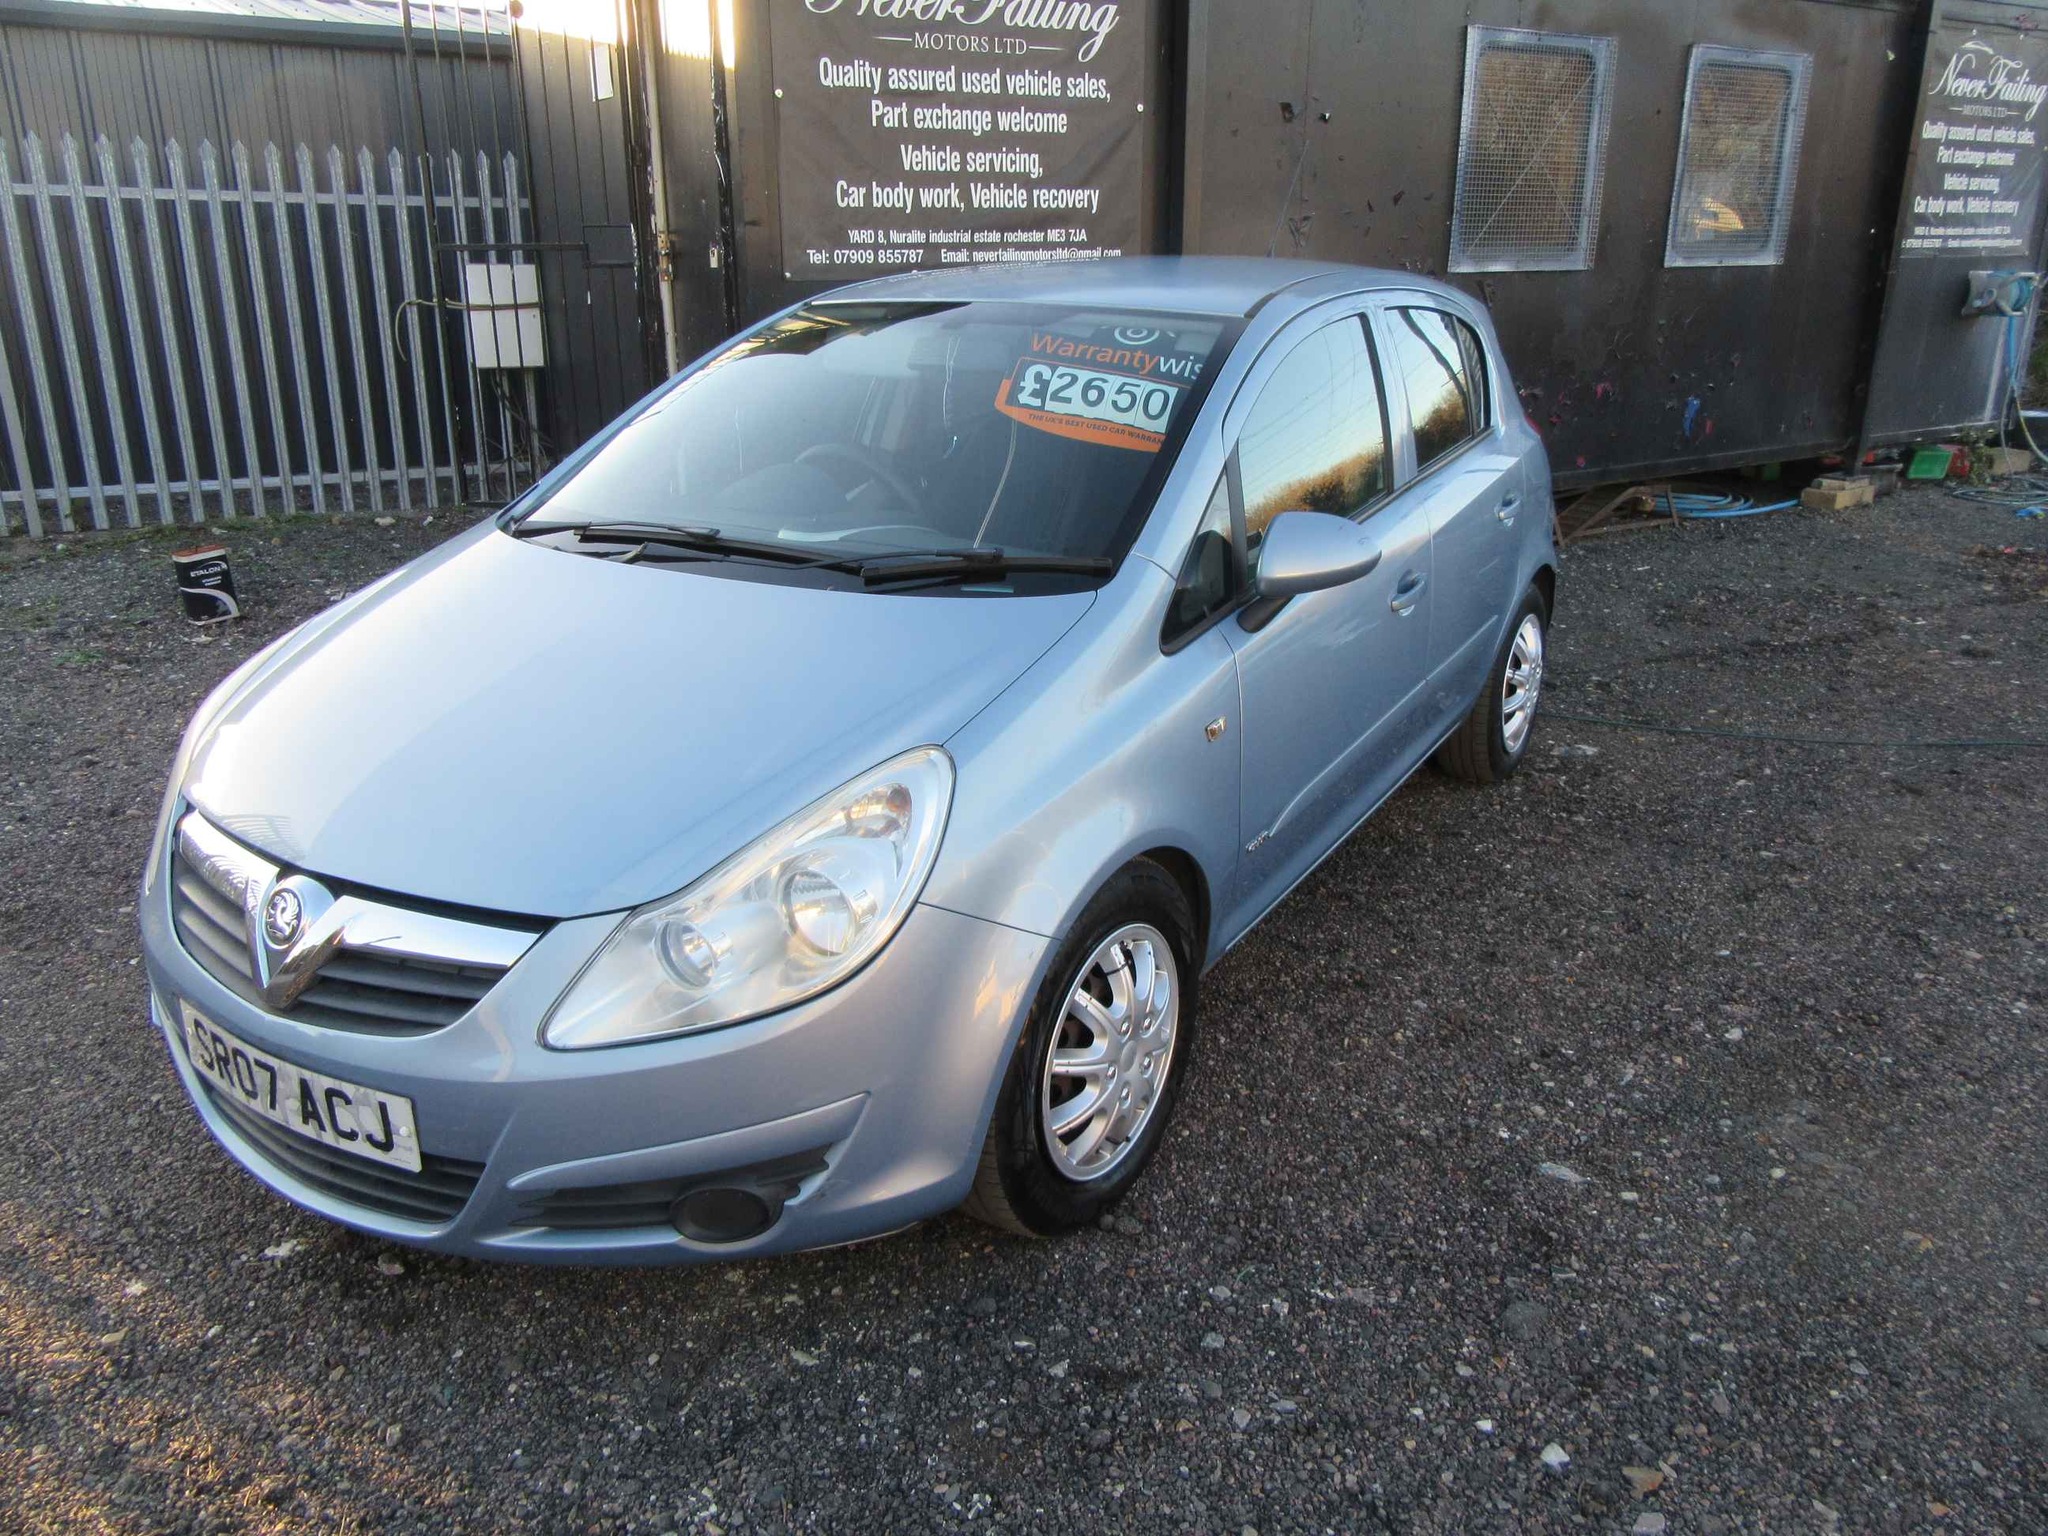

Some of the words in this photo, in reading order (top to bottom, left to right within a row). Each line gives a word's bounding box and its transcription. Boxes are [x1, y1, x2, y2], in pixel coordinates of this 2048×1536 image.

[914, 32, 989, 53] MOTORS
[994, 37, 1027, 54] LTD
[819, 57, 882, 94] Quality
[888, 65, 956, 92] assured
[962, 67, 1000, 94] used
[1006, 69, 1062, 97] vehicle
[1066, 72, 1111, 102] sales,
[1928, 52, 1987, 98] Never
[1983, 55, 2048, 121] Failing
[871, 99, 908, 128] Part
[913, 102, 992, 136] exchange
[997, 106, 1067, 133] welcome
[900, 144, 961, 173] Vehicle
[966, 149, 1043, 178] servicing,
[836, 180, 867, 208] Car
[872, 181, 914, 214] body
[919, 183, 965, 213] work,
[970, 183, 1027, 209] Vehicle
[1033, 183, 1100, 214] recovery
[848, 229, 875, 244] YARD
[877, 230, 887, 245] 8,
[889, 229, 926, 244] Nuralite
[929, 229, 971, 243] industrial
[973, 229, 1001, 243] estate
[1003, 229, 1044, 243] rochester
[1047, 229, 1066, 242] ME3
[1068, 229, 1087, 242] 7JA
[806, 249, 830, 264] Tel:
[833, 249, 874, 264] 07909
[878, 249, 924, 264] 855787
[941, 248, 970, 263] Email:
[1017, 364, 1170, 421] £2650
[194, 1018, 277, 1111] SR07
[299, 1077, 395, 1152] ACJ
